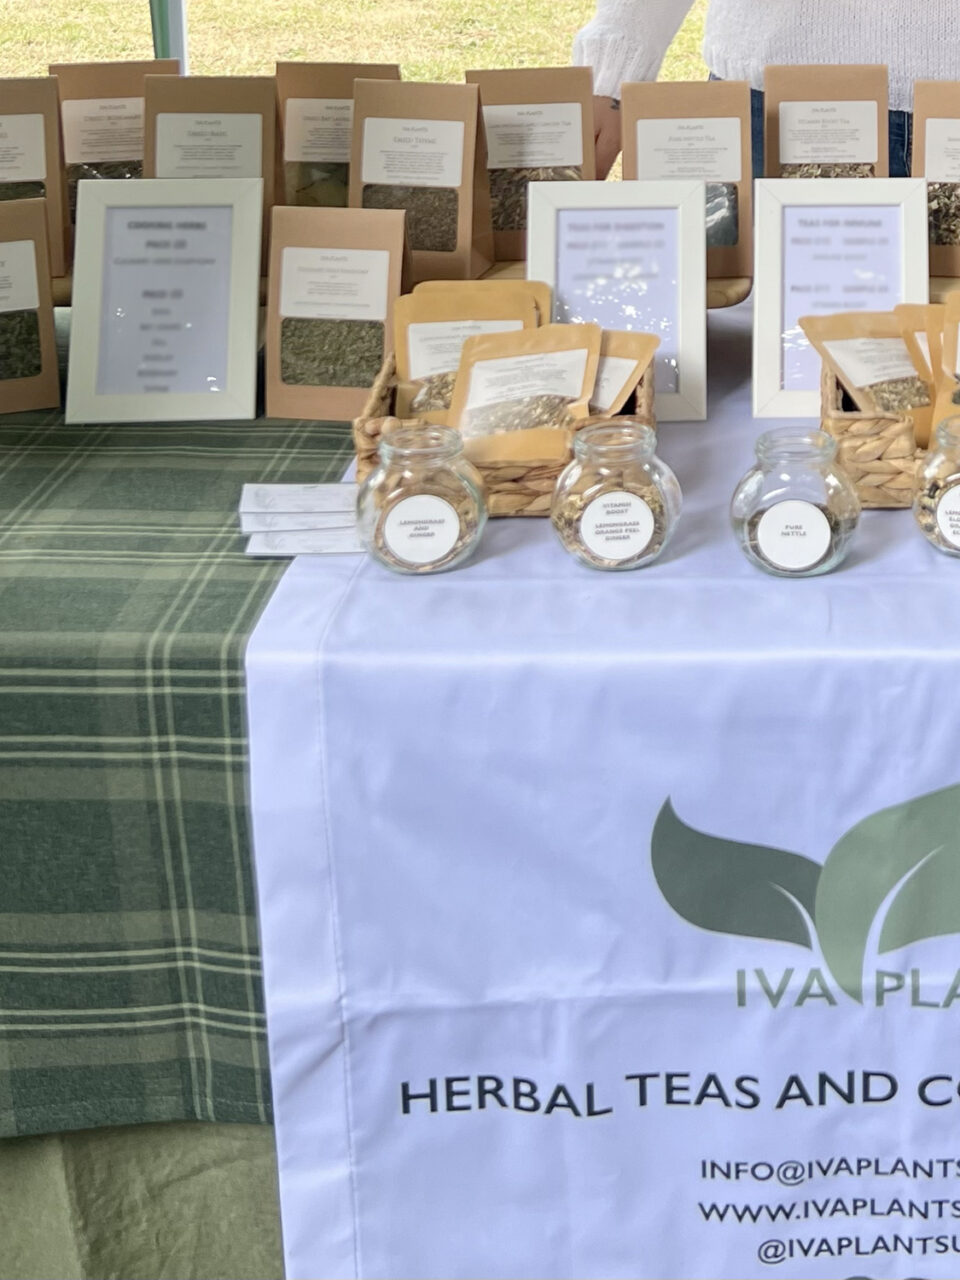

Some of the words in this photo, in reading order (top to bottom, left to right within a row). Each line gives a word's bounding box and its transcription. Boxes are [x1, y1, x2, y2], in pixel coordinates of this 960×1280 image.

[736, 967, 838, 1008] IVA
[401, 1076, 613, 1117] HERBAL
[625, 1072, 760, 1110] TEAS
[775, 1071, 898, 1109] AND
